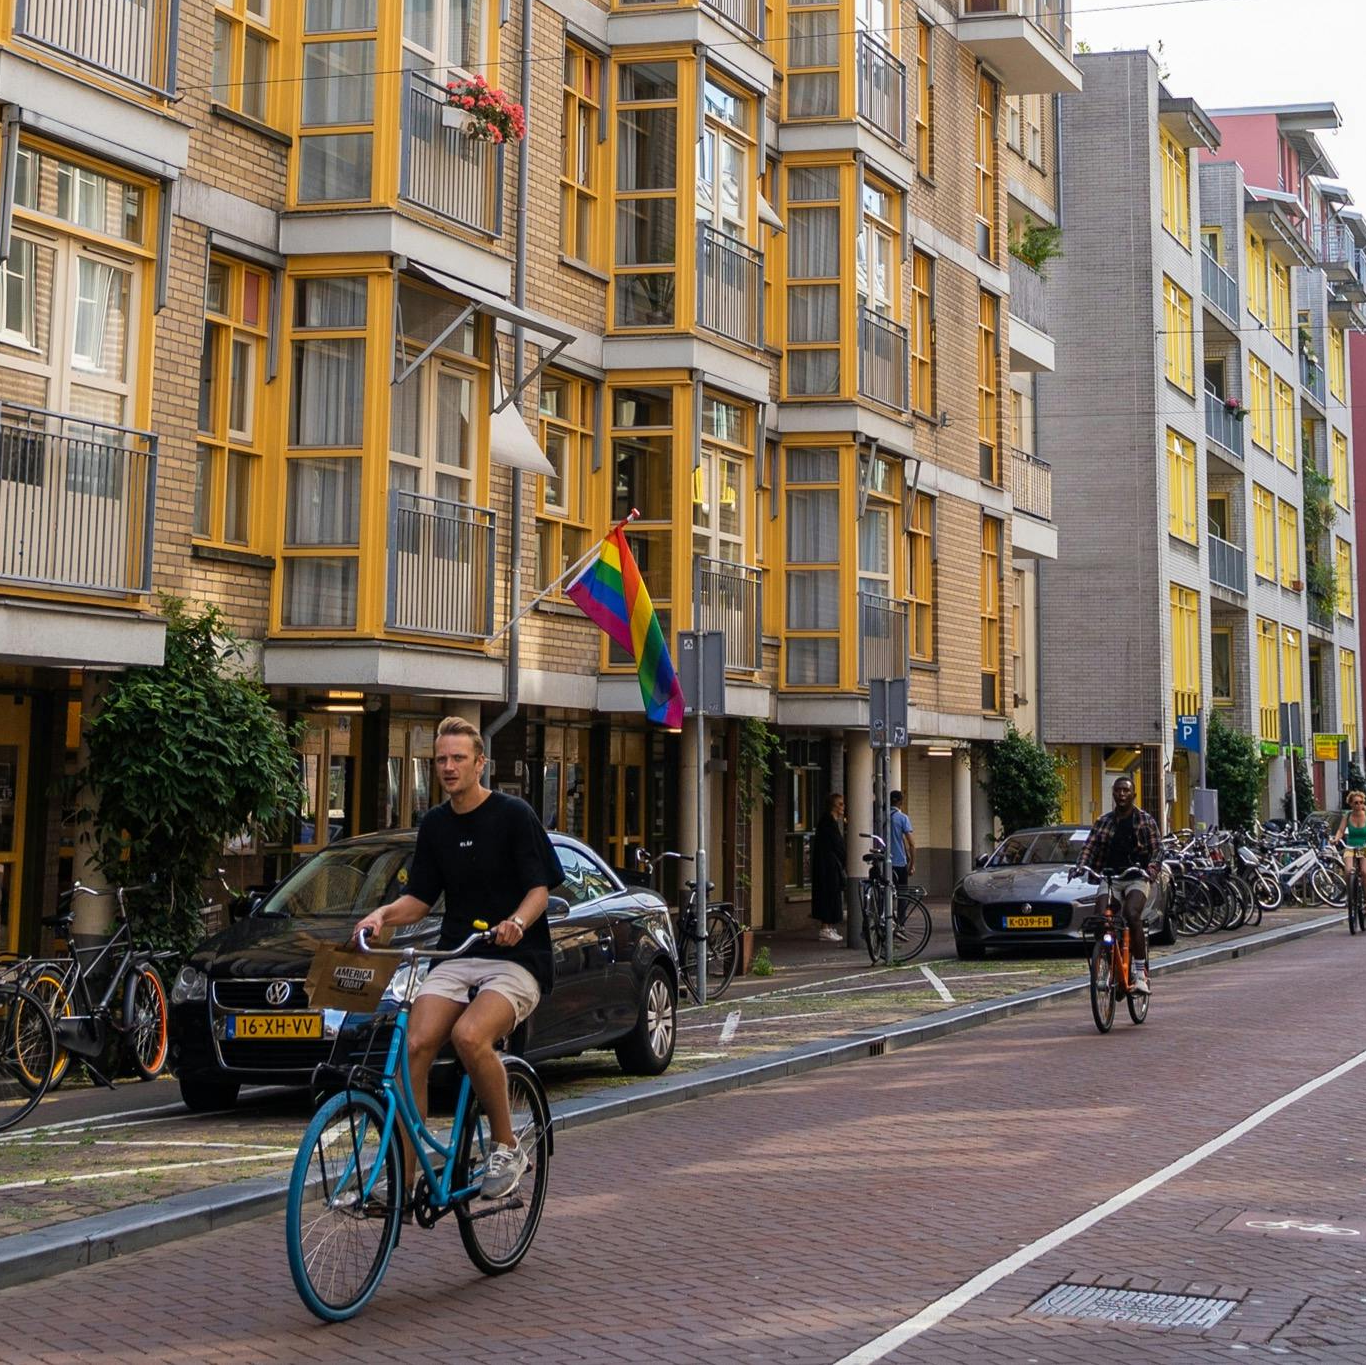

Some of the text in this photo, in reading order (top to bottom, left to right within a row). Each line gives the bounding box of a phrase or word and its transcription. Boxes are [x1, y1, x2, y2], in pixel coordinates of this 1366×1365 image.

[1183, 725, 1193, 741] P
[335, 967, 373, 981] AMERICA
[339, 979, 364, 990] TODAY
[242, 1018, 314, 1035] 16-XH-VV
